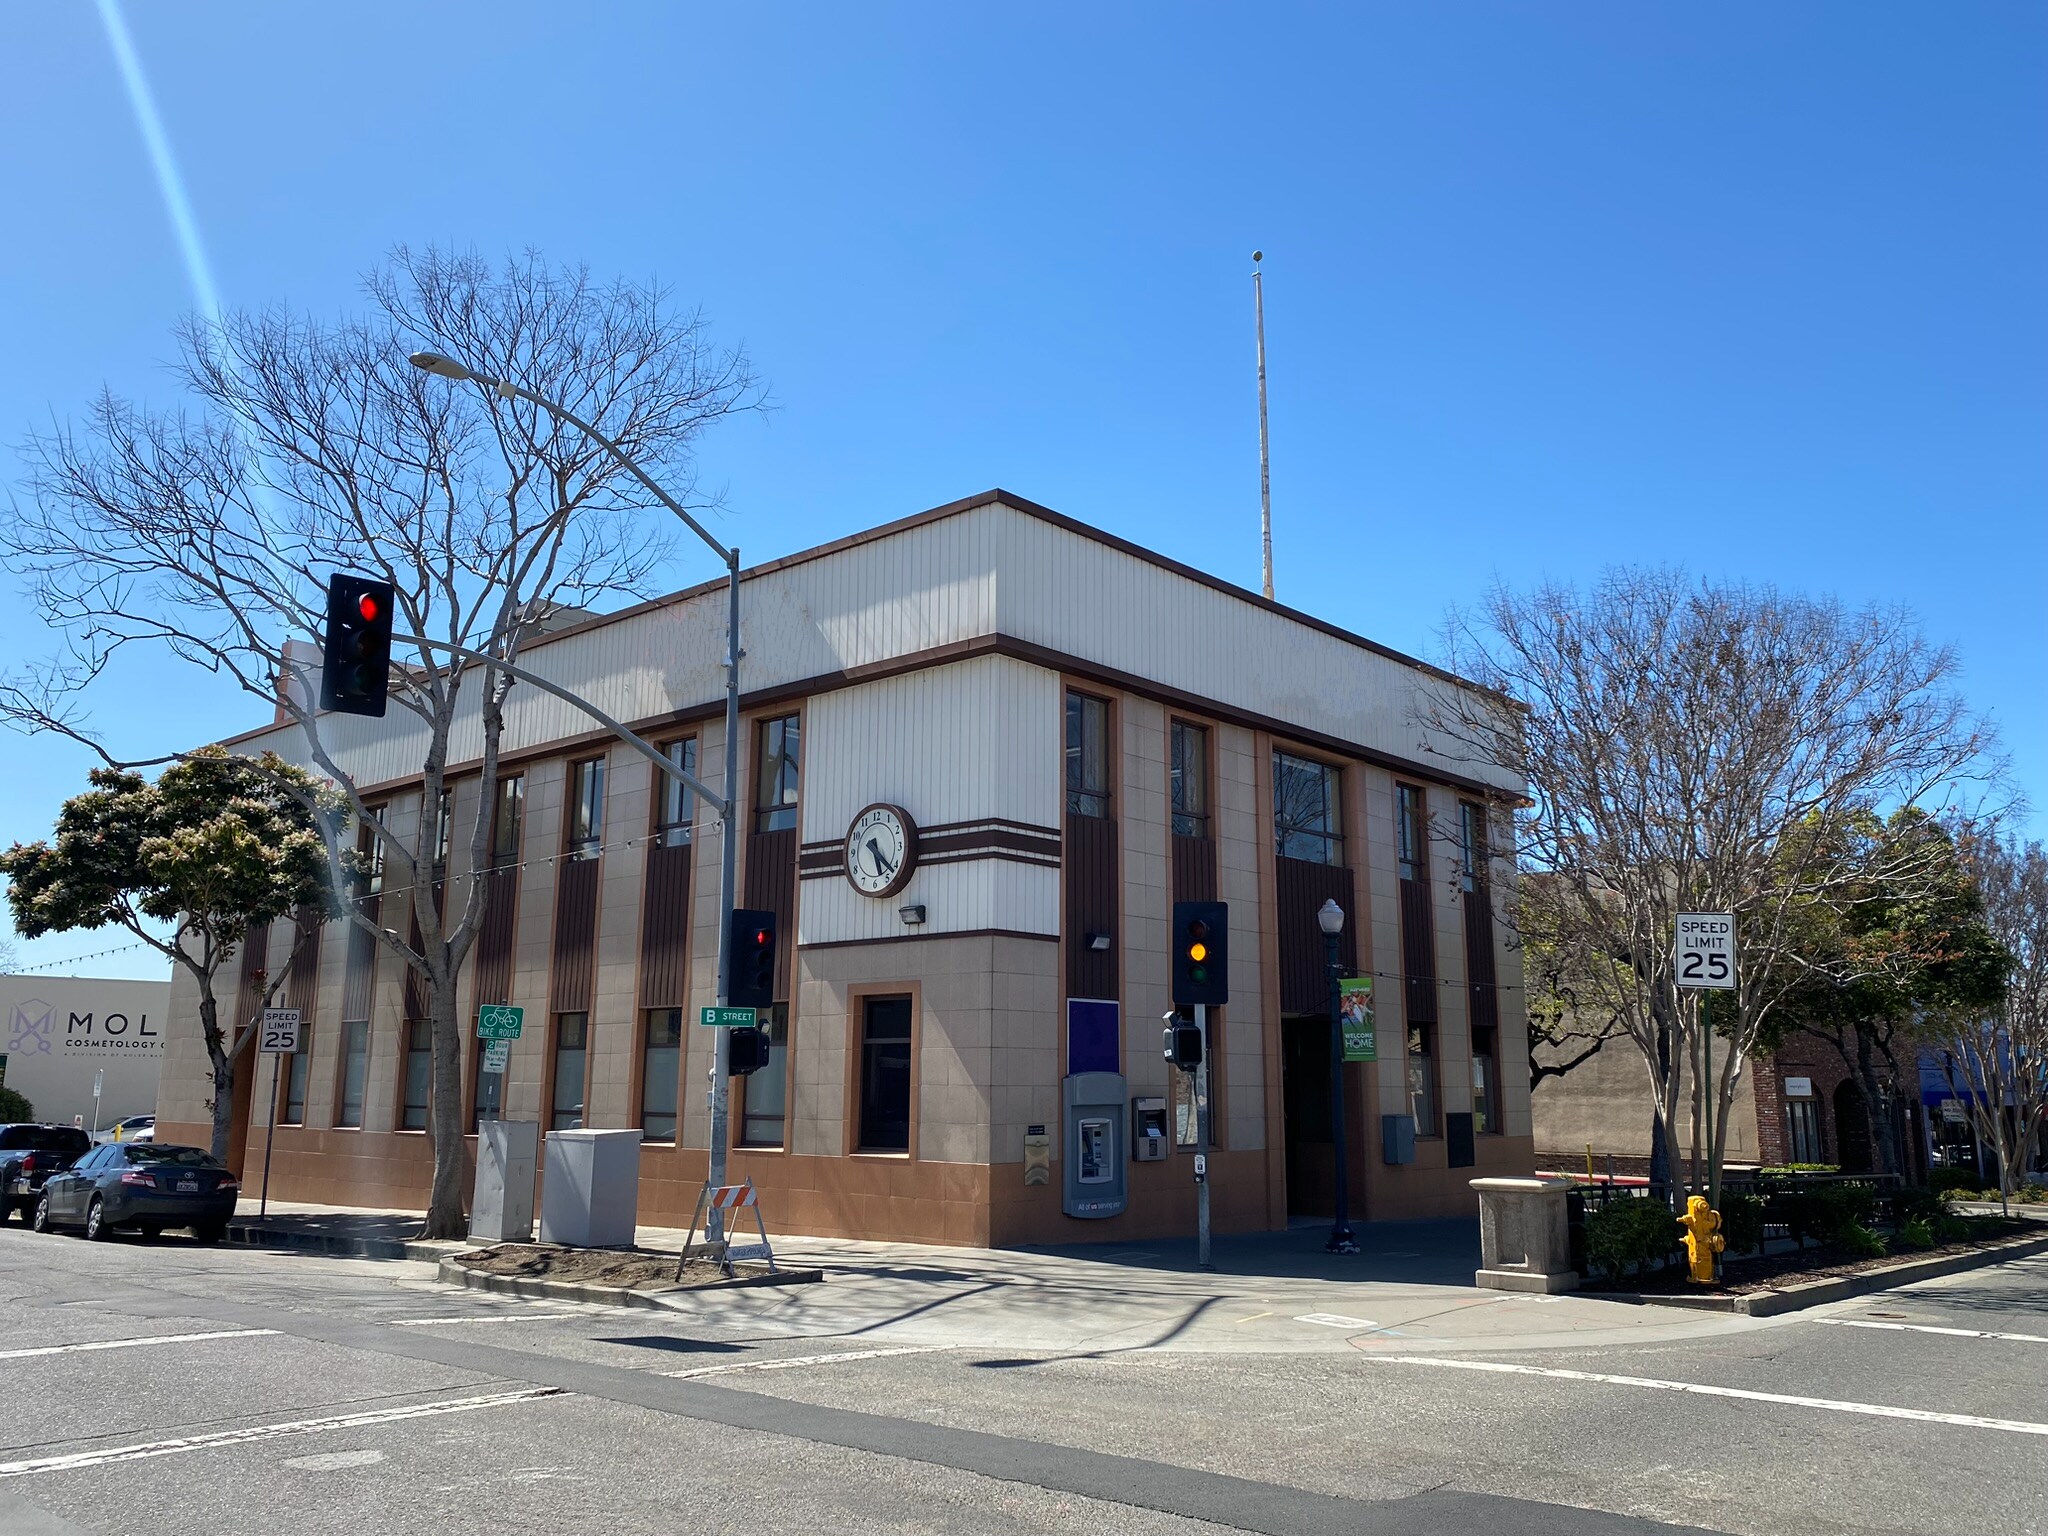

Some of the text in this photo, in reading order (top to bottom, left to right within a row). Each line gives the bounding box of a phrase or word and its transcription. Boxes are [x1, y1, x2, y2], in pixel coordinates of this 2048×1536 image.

[873, 811, 881, 821] 12
[887, 813, 890, 823] 1
[861, 818, 868, 827] 11
[895, 825, 900, 834] 2
[853, 831, 860, 841] 10
[897, 842, 902, 851] 3
[850, 848, 856, 858] 9
[894, 860, 898, 869] 4
[853, 865, 858, 875] 8
[861, 877, 866, 886] 7
[885, 873, 890, 883] 5
[872, 879, 878, 889] 6
[1681, 921, 1729, 934] SPEED
[1685, 936, 1725, 949] LIMIT
[1682, 952, 1729, 980] 25
[265, 1012, 298, 1021] SPEED
[706, 1009, 753, 1023] B STREET
[67, 1012, 157, 1036] MOL
[268, 1022, 294, 1030] LIMIT
[478, 1027, 520, 1038] BIKE ROUTE
[65, 1039, 156, 1049] COSMETOLOGY
[264, 1031, 295, 1048] 25
[488, 1040, 495, 1049] 2
[1345, 1038, 1374, 1049] HOME
